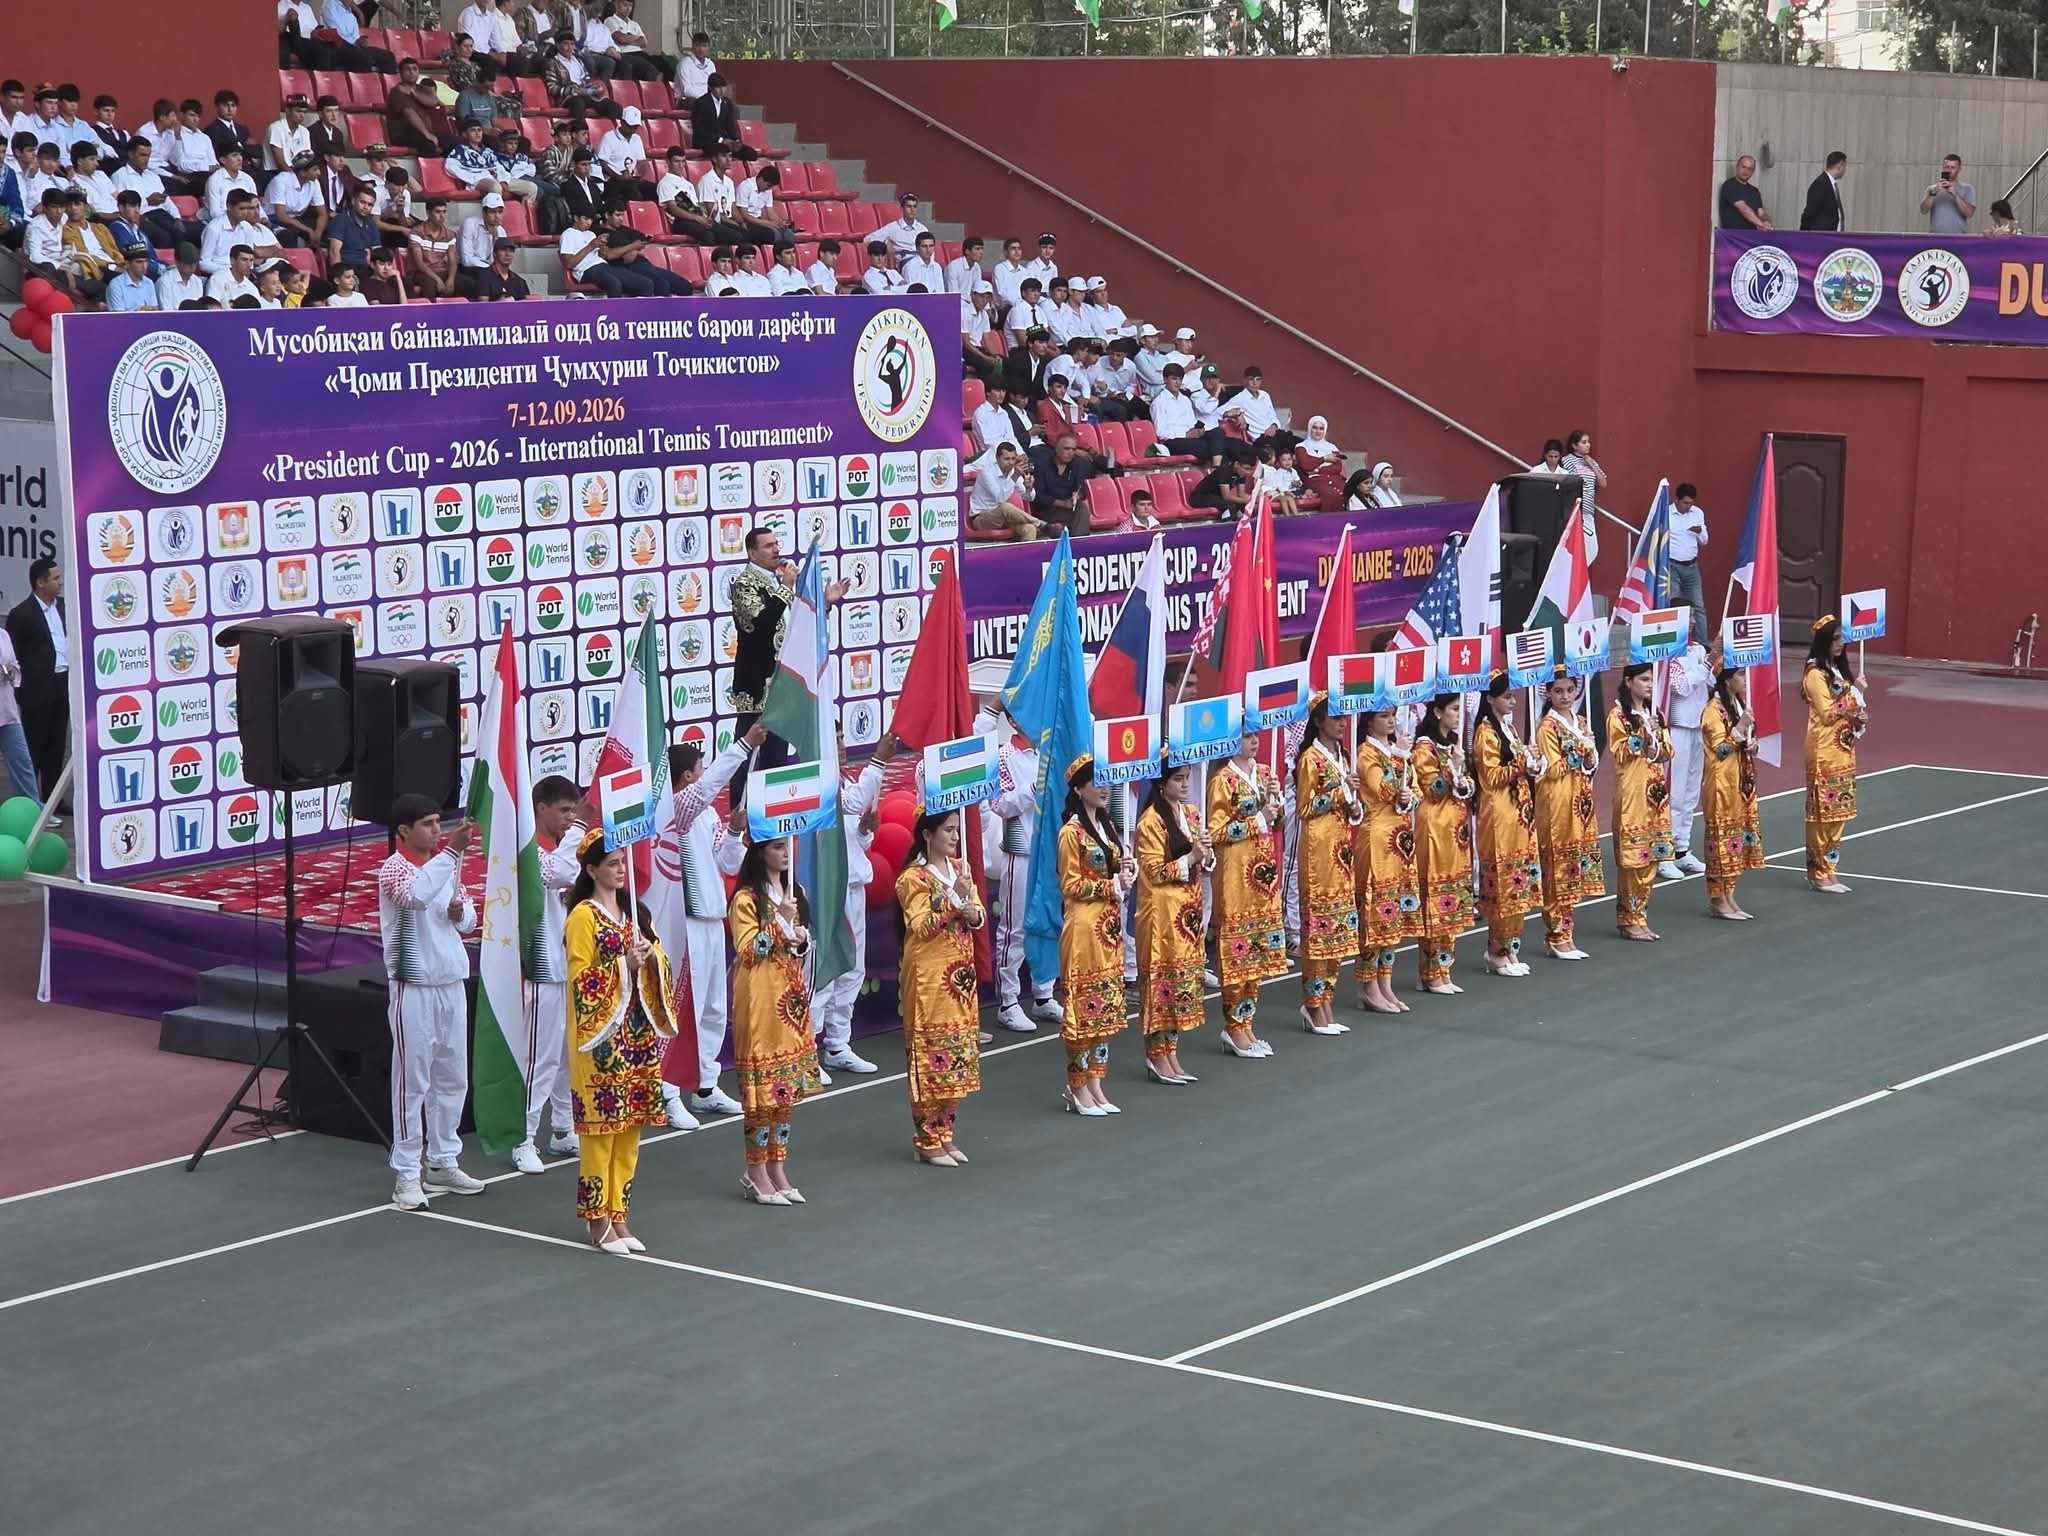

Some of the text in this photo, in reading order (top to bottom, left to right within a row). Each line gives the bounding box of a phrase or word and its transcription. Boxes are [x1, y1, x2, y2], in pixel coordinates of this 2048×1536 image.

[1906, 251, 1963, 275] TAJIKISTAN
[248, 311, 836, 362] Мусобиқаи байналмилалӣ оид ба теннис барои дарёфти
[859, 312, 928, 353] TAJIKISTAN
[325, 351, 780, 399] «Ҷоми Президенти Ҷумҳурии Тоҷикистон»
[507, 397, 625, 428] 7-12.09.2026
[857, 378, 931, 437] TENNIS FEDERATION
[262, 450, 379, 482] «President
[386, 446, 430, 478] Cup
[450, 439, 500, 468] 2026
[518, 429, 643, 463] International
[649, 425, 710, 453] Tennis
[715, 421, 834, 449] Tournament»
[896, 463, 915, 473] World
[848, 471, 868, 483] POT
[897, 473, 917, 483] Tennis
[495, 492, 518, 504] World
[436, 503, 461, 516] POT
[496, 504, 521, 515] Tennis
[938, 509, 956, 518] World
[275, 521, 306, 530] TAJIKISTAN
[890, 517, 910, 528] POT
[938, 518, 957, 527] Tennis
[0, 514, 57, 560] nis
[545, 543, 569, 553] World
[488, 553, 512, 566] POT
[546, 553, 570, 564] Tennis
[931, 562, 944, 573] PO
[1163, 547, 1197, 585] CUP
[1318, 549, 1392, 588] DANBE
[1403, 544, 1434, 577] 2026
[332, 573, 362, 582] TAJIKISTAN
[594, 591, 617, 601] World
[538, 601, 562, 614] POT
[595, 600, 618, 611] Tennis
[973, 602, 1120, 658] INTERONAL
[1165, 593, 1191, 633] NIS
[118, 646, 147, 659] World
[588, 649, 610, 662] POT
[1647, 647, 1670, 659] INDIA
[119, 659, 149, 671] Tennis
[689, 685, 710, 694] World
[1399, 689, 1418, 700] CHINA
[180, 698, 207, 711] World
[690, 694, 711, 705] Tennis
[1340, 696, 1375, 711] BELARUS
[111, 712, 139, 727] POT
[181, 710, 210, 723] Tennis
[1262, 709, 1293, 726] RUSSIA
[684, 740, 704, 753] OT
[1172, 738, 1240, 763] KAZAKHSTAN
[172, 763, 200, 778] POT
[1098, 761, 1158, 782] KYRGYZSTAN
[931, 781, 996, 810] UZBEKISTAN
[295, 797, 321, 810] World
[230, 811, 257, 827] POT
[295, 808, 322, 821] Tennis
[777, 815, 808, 833] IRAN
[611, 819, 650, 846] TAJIKISTAN
